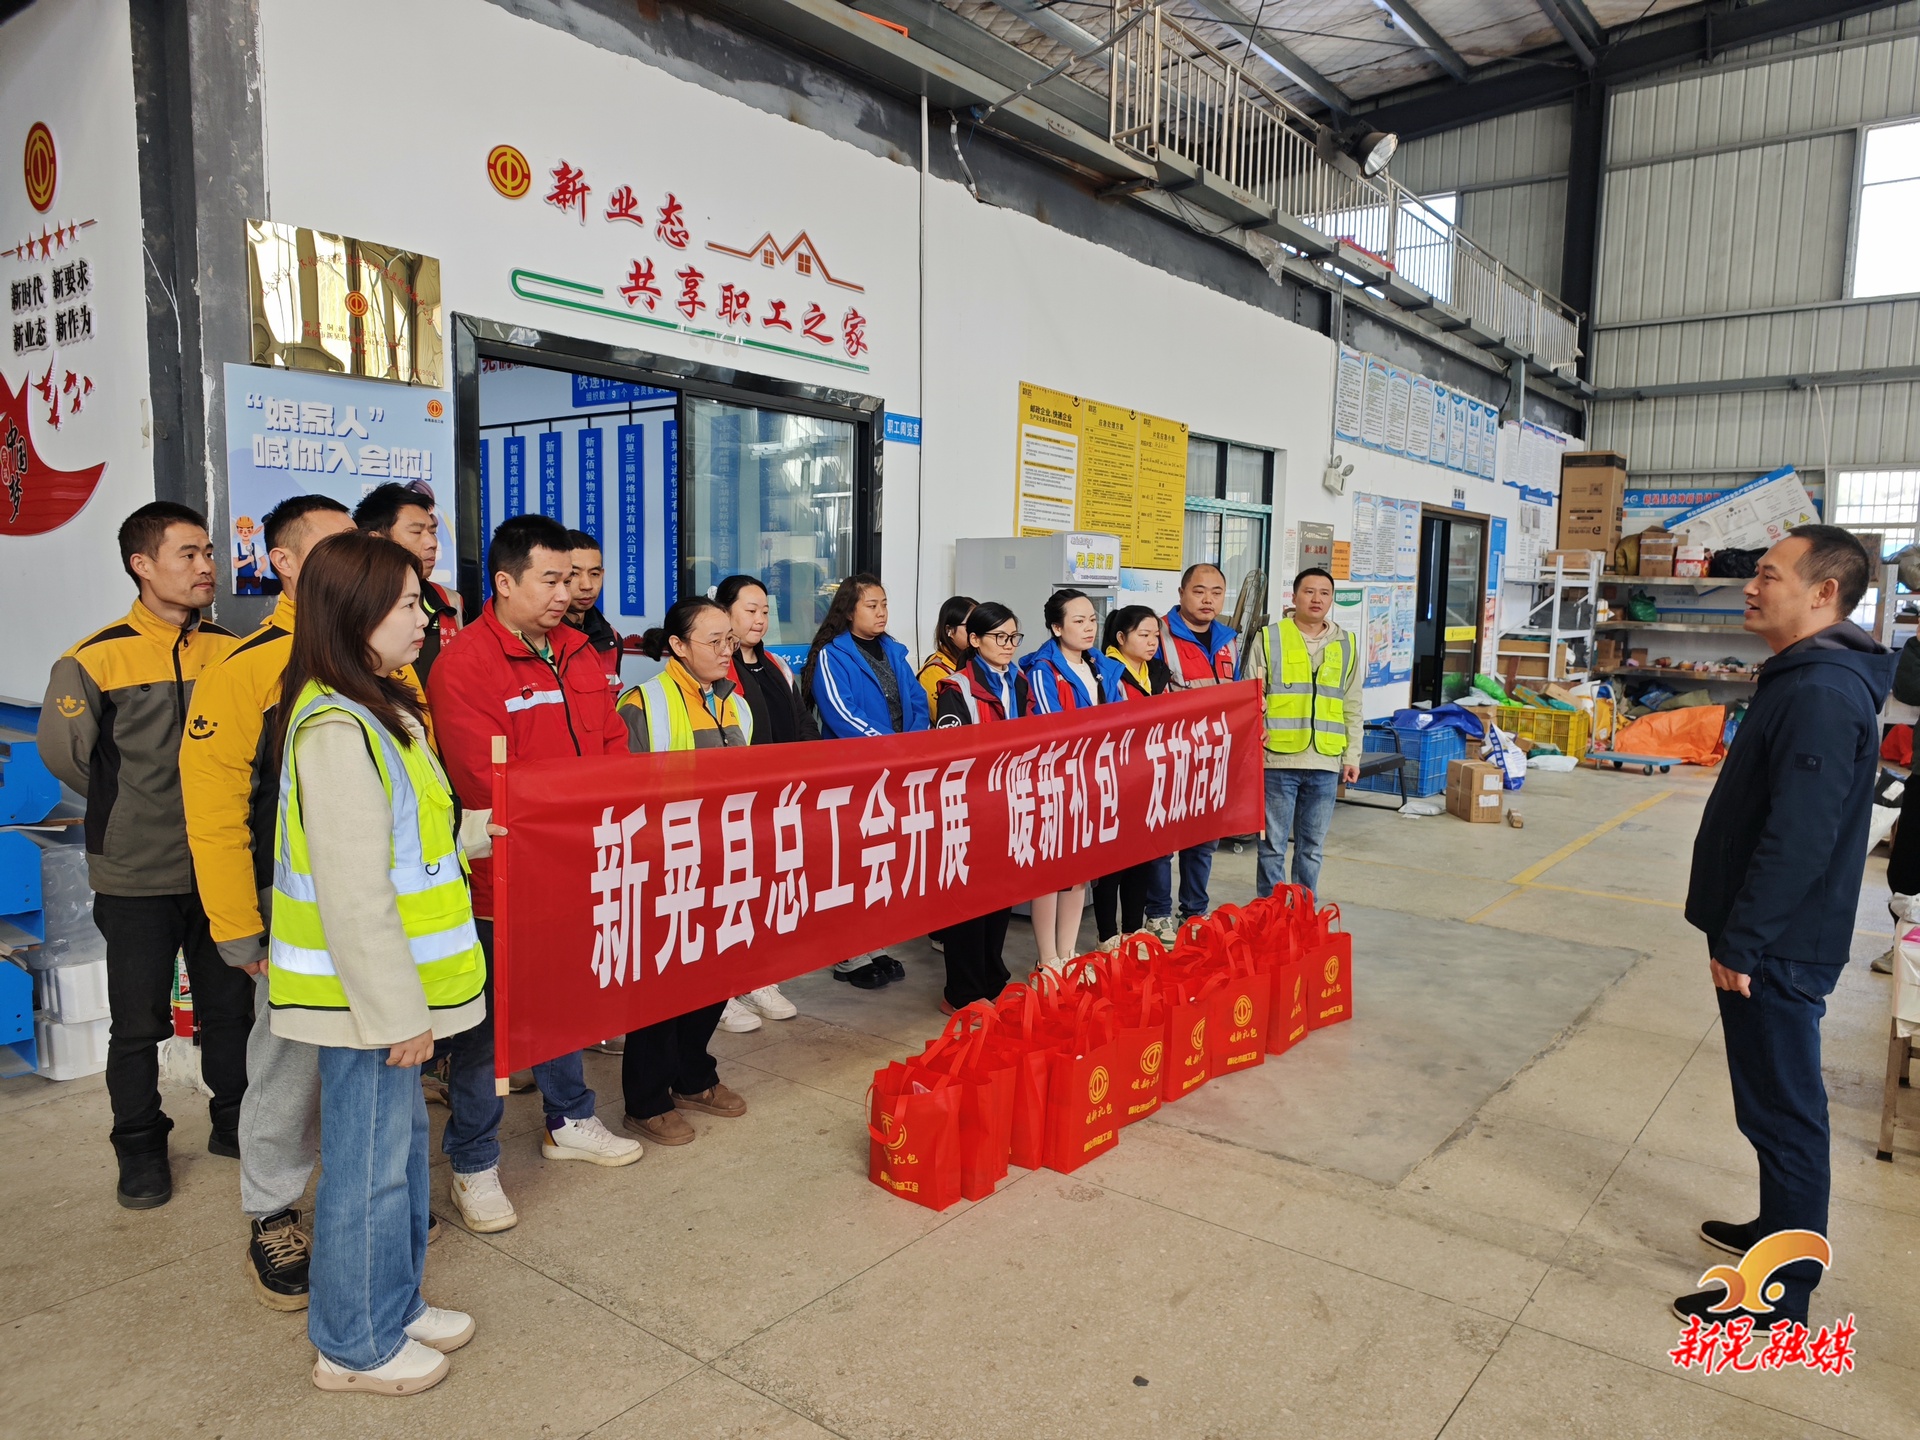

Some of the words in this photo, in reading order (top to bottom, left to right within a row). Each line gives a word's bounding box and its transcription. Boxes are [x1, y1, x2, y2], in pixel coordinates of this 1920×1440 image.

[546, 159, 689, 249] 新业态
[11, 276, 44, 311] 新时代
[52, 260, 89, 298] 新要求
[56, 304, 91, 342] 新作为
[619, 257, 869, 356] 共享职工之家
[13, 317, 47, 351] 新业态
[886, 418, 920, 438] 职工阅览室
[625, 432, 637, 605] 新晃三顺网络科技有限公司工会委员会
[590, 711, 1227, 989] 新晃县总工会开展“暖新礼包”发放活动
